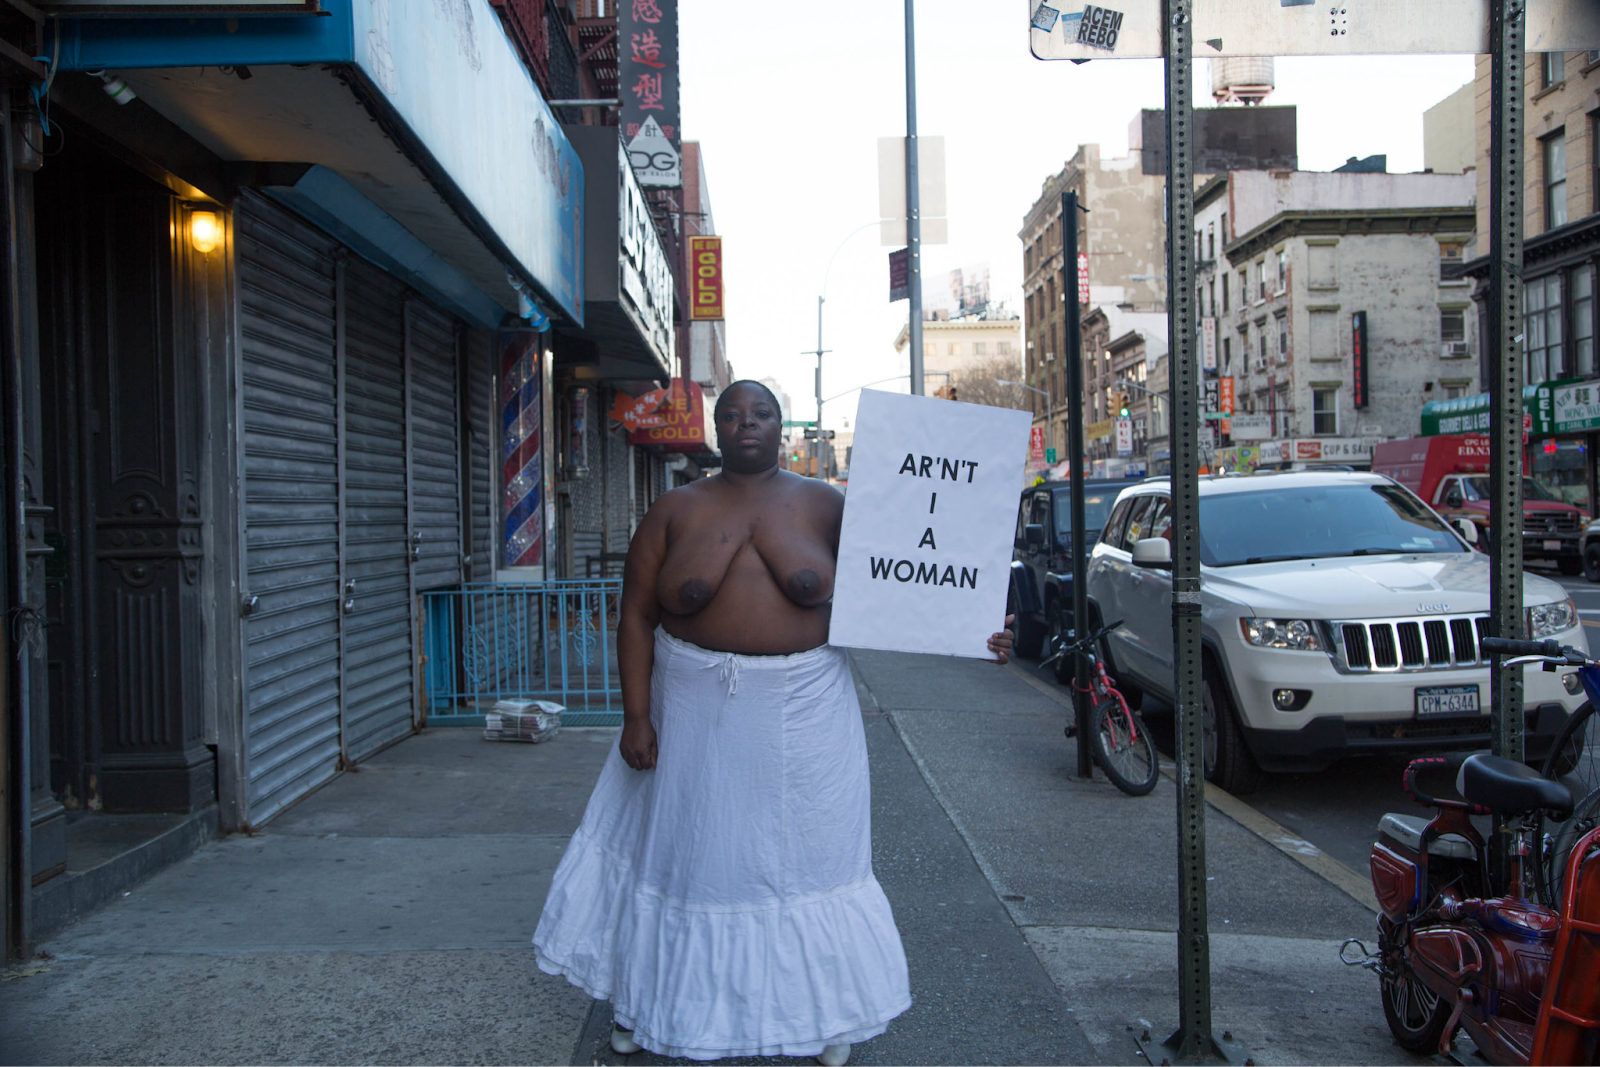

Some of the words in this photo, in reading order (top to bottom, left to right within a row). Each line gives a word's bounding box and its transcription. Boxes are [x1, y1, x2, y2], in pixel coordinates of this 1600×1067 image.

[1081, 5, 1124, 31] ACEM
[1078, 22, 1118, 48] REBO
[698, 252, 717, 304] GOLD
[1539, 388, 1550, 433] DELI
[649, 427, 702, 439] GOLD
[1198, 441, 1212, 450] 25
[1323, 444, 1340, 455] CUP
[1343, 443, 1349, 454] &
[1352, 443, 1368, 454] SAU
[899, 453, 978, 483] AR'N'T
[930, 492, 936, 514] I
[918, 527, 936, 550] A
[870, 556, 978, 589] WOMAN
[1416, 602, 1451, 613] Jeep
[1448, 694, 1473, 711] 6344
